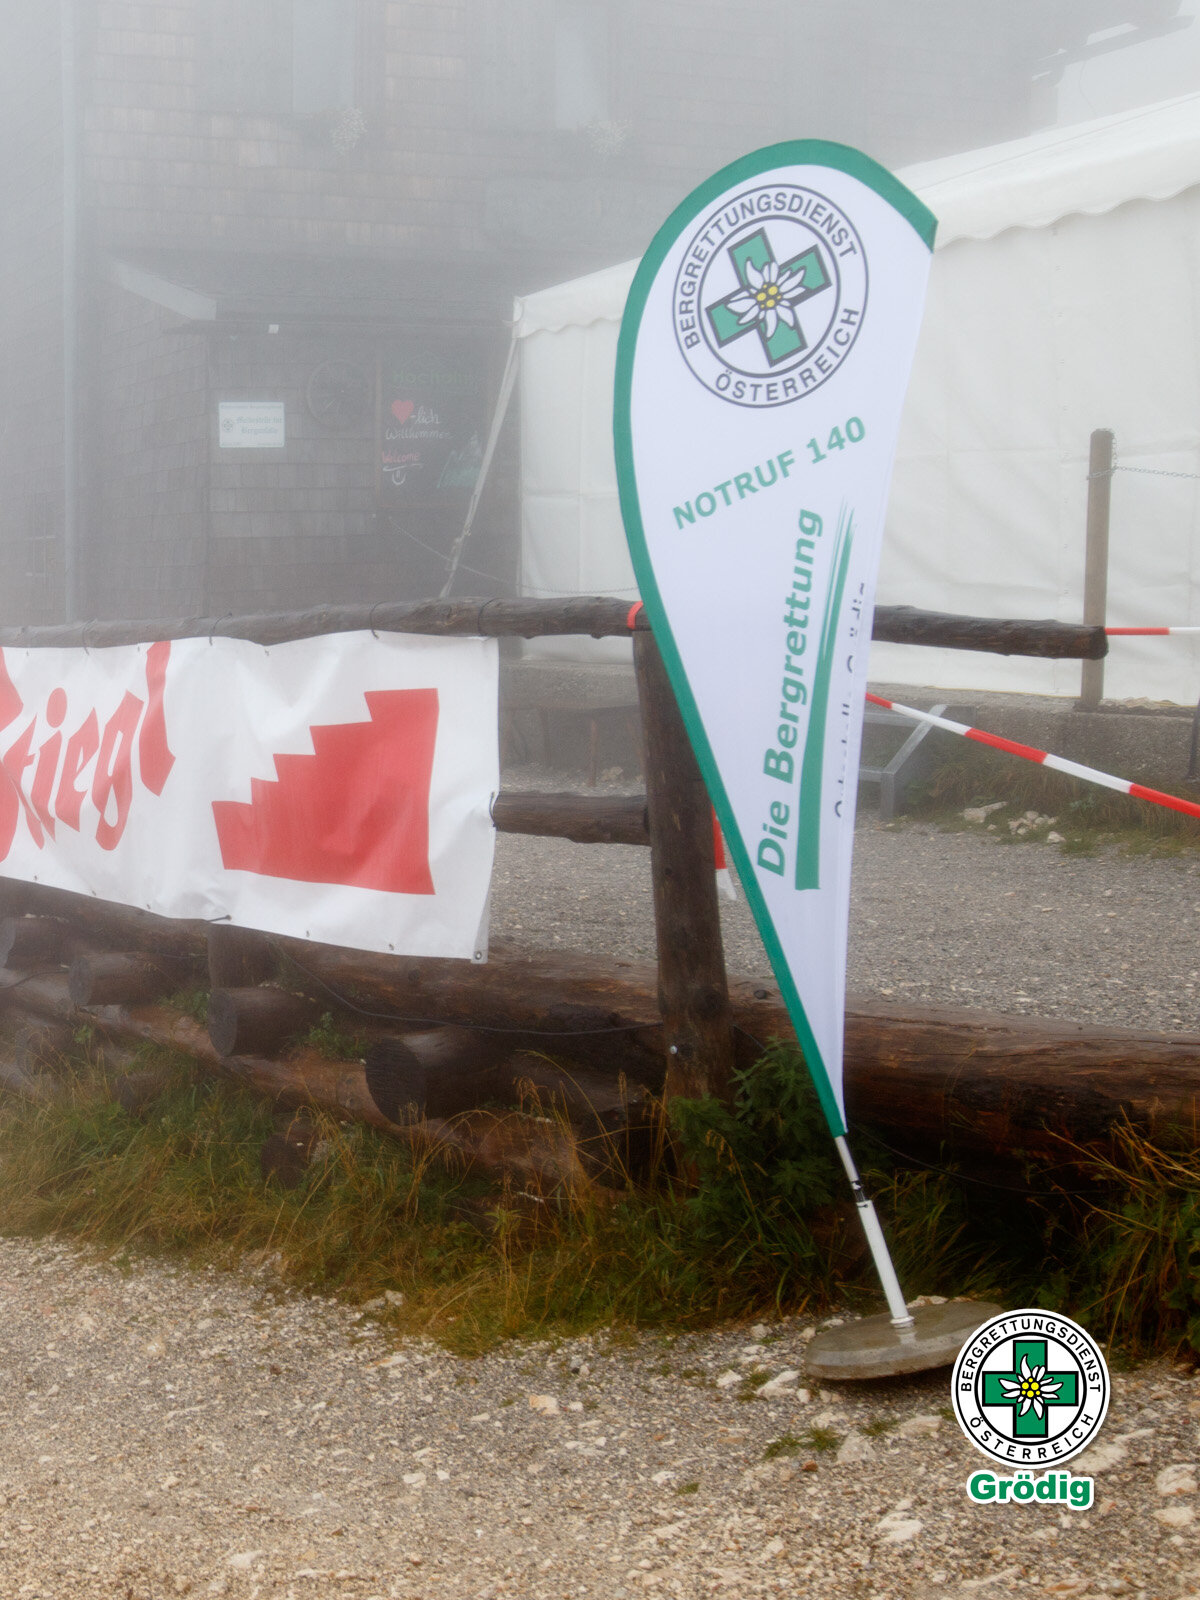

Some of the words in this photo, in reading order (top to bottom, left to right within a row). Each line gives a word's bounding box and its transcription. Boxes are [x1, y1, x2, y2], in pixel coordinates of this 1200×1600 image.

[679, 192, 858, 350] BERGRETTUNGSDIENST
[715, 308, 860, 402] ÖSTERREICH
[672, 449, 796, 530] NOTRUF
[806, 416, 866, 464] 140
[762, 509, 823, 784] Bergrettung
[757, 800, 790, 877] Die
